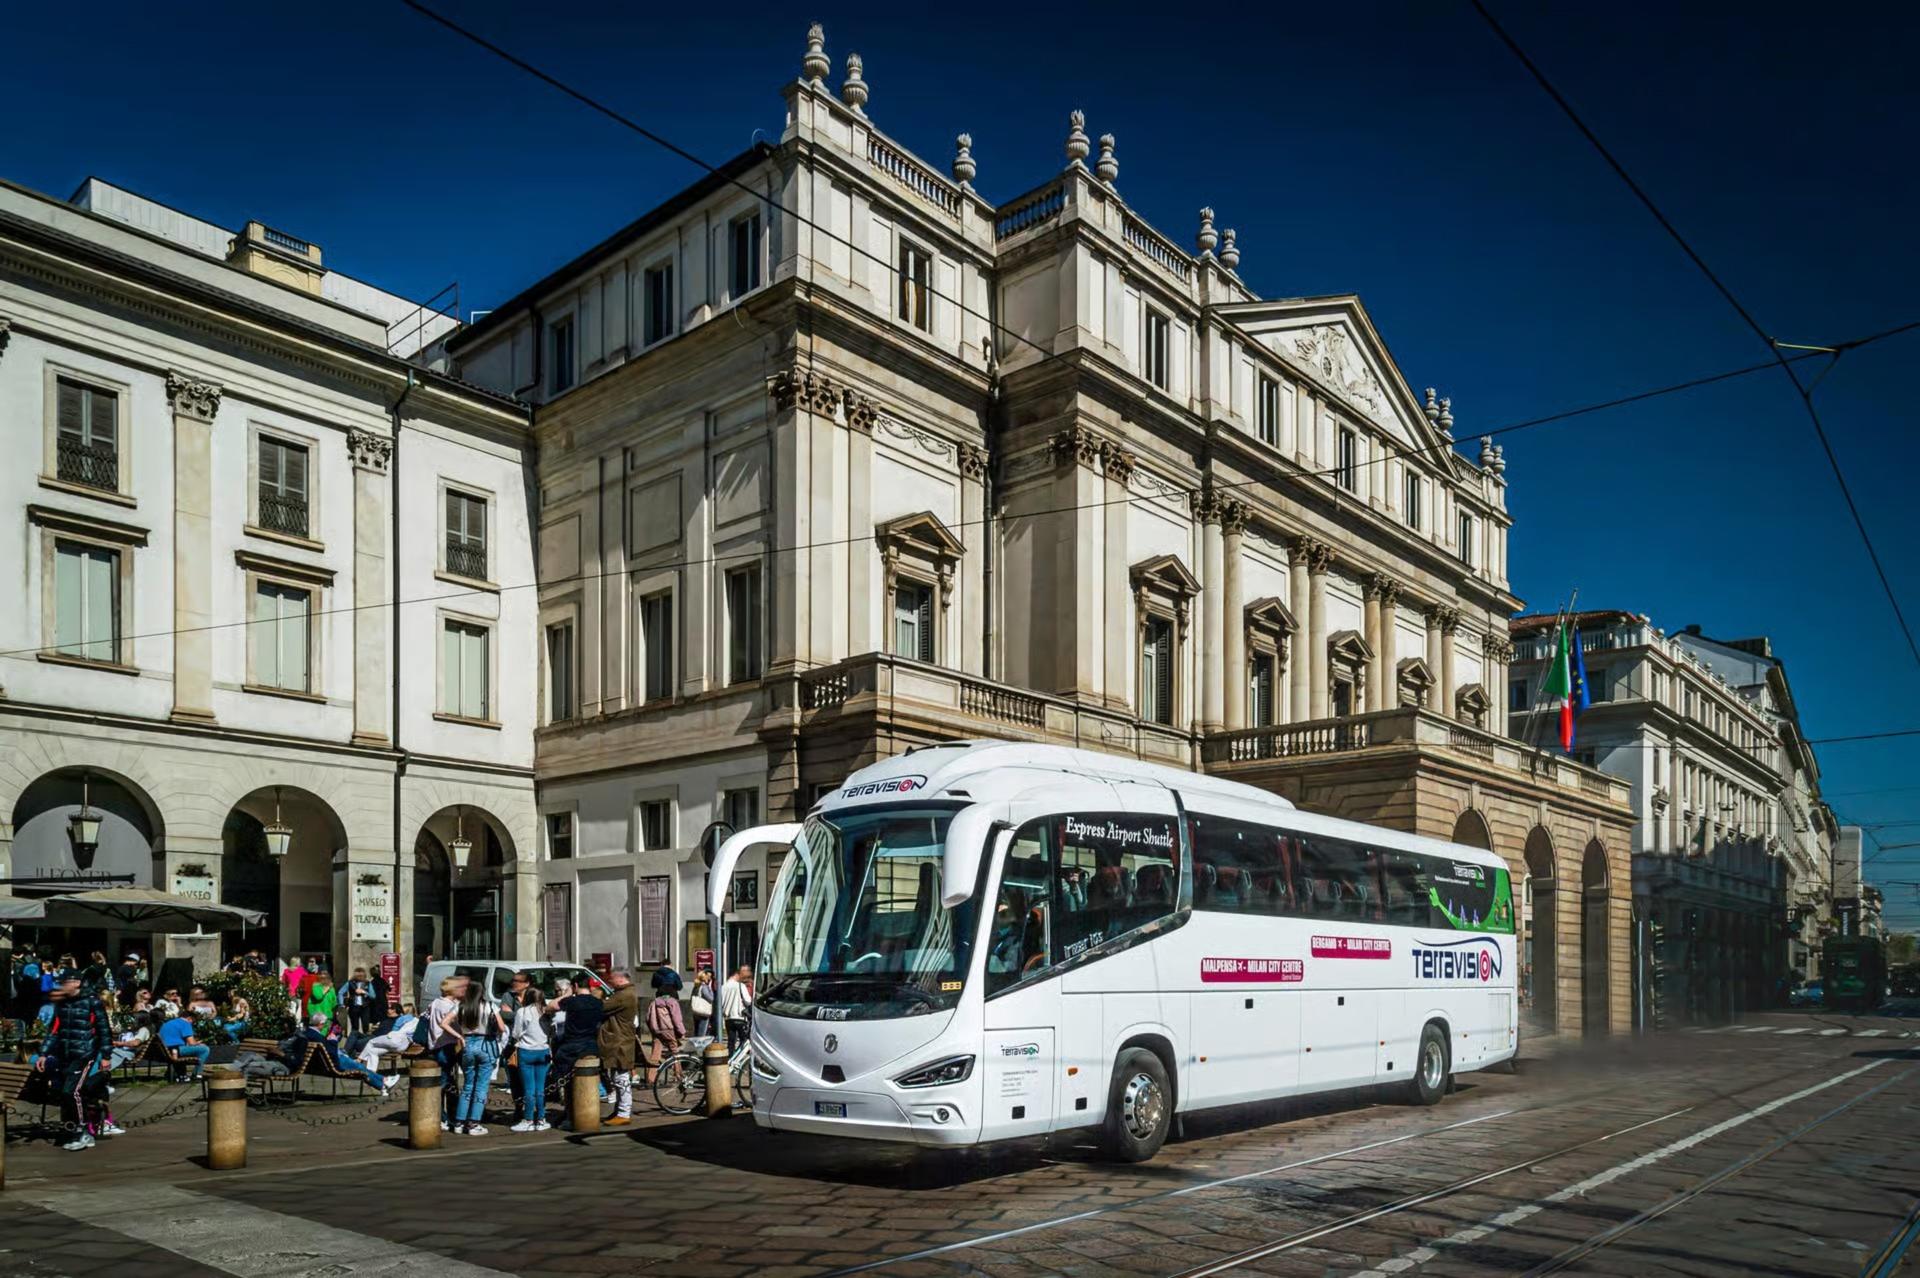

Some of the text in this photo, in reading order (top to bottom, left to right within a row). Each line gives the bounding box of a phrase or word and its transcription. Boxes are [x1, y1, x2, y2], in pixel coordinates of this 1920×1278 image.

[1065, 816, 1174, 847] Express Airport Shuttle
[354, 914, 390, 924] TEATRALE
[1347, 938, 1362, 950] MILAN
[1363, 939, 1373, 951] CITY
[1373, 939, 1390, 951] CENTRE
[1202, 959, 1238, 973] MALPENSA
[1247, 960, 1267, 973] MILAN
[1268, 960, 1281, 973] CITY
[1281, 960, 1302, 973] CENTRE
